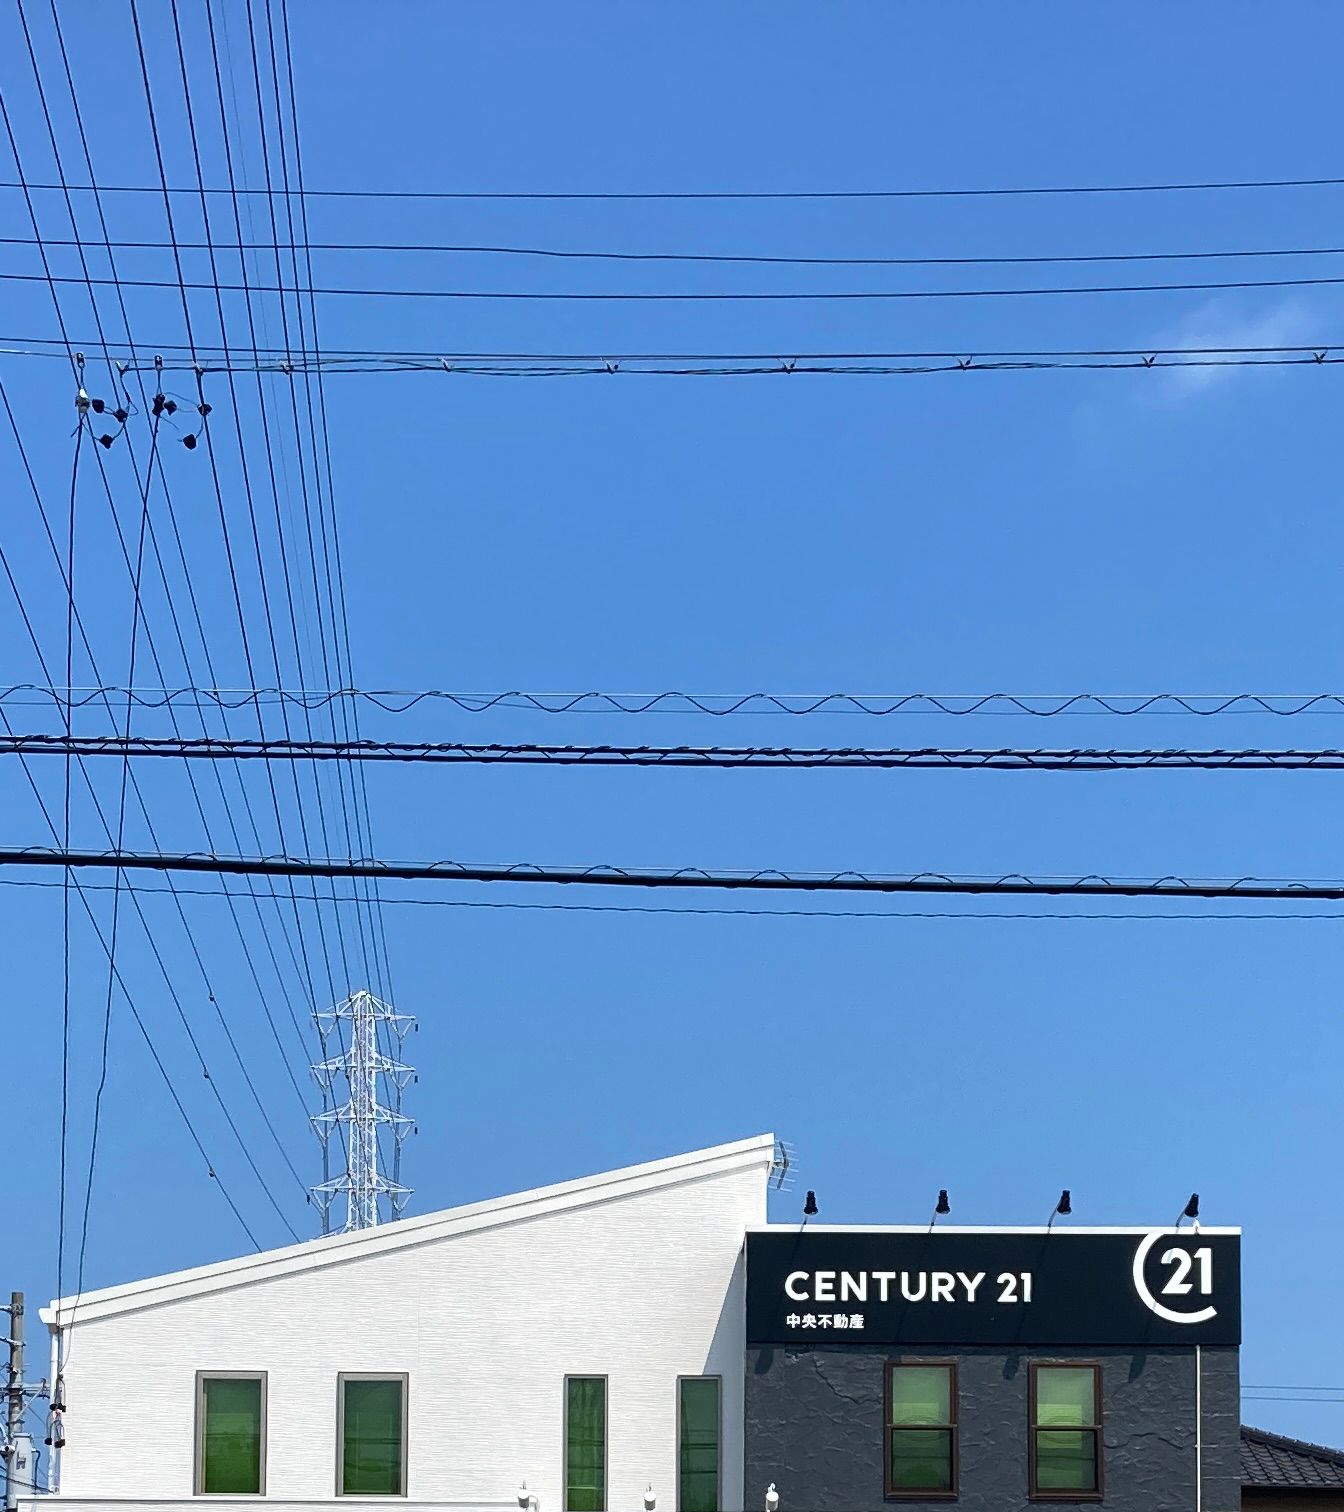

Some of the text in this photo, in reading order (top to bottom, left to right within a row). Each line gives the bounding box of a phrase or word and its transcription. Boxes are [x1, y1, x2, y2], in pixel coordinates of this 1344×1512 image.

[784, 1271, 1032, 1302] CENTURY 21
[786, 1312, 865, 1329] 中央不動産
